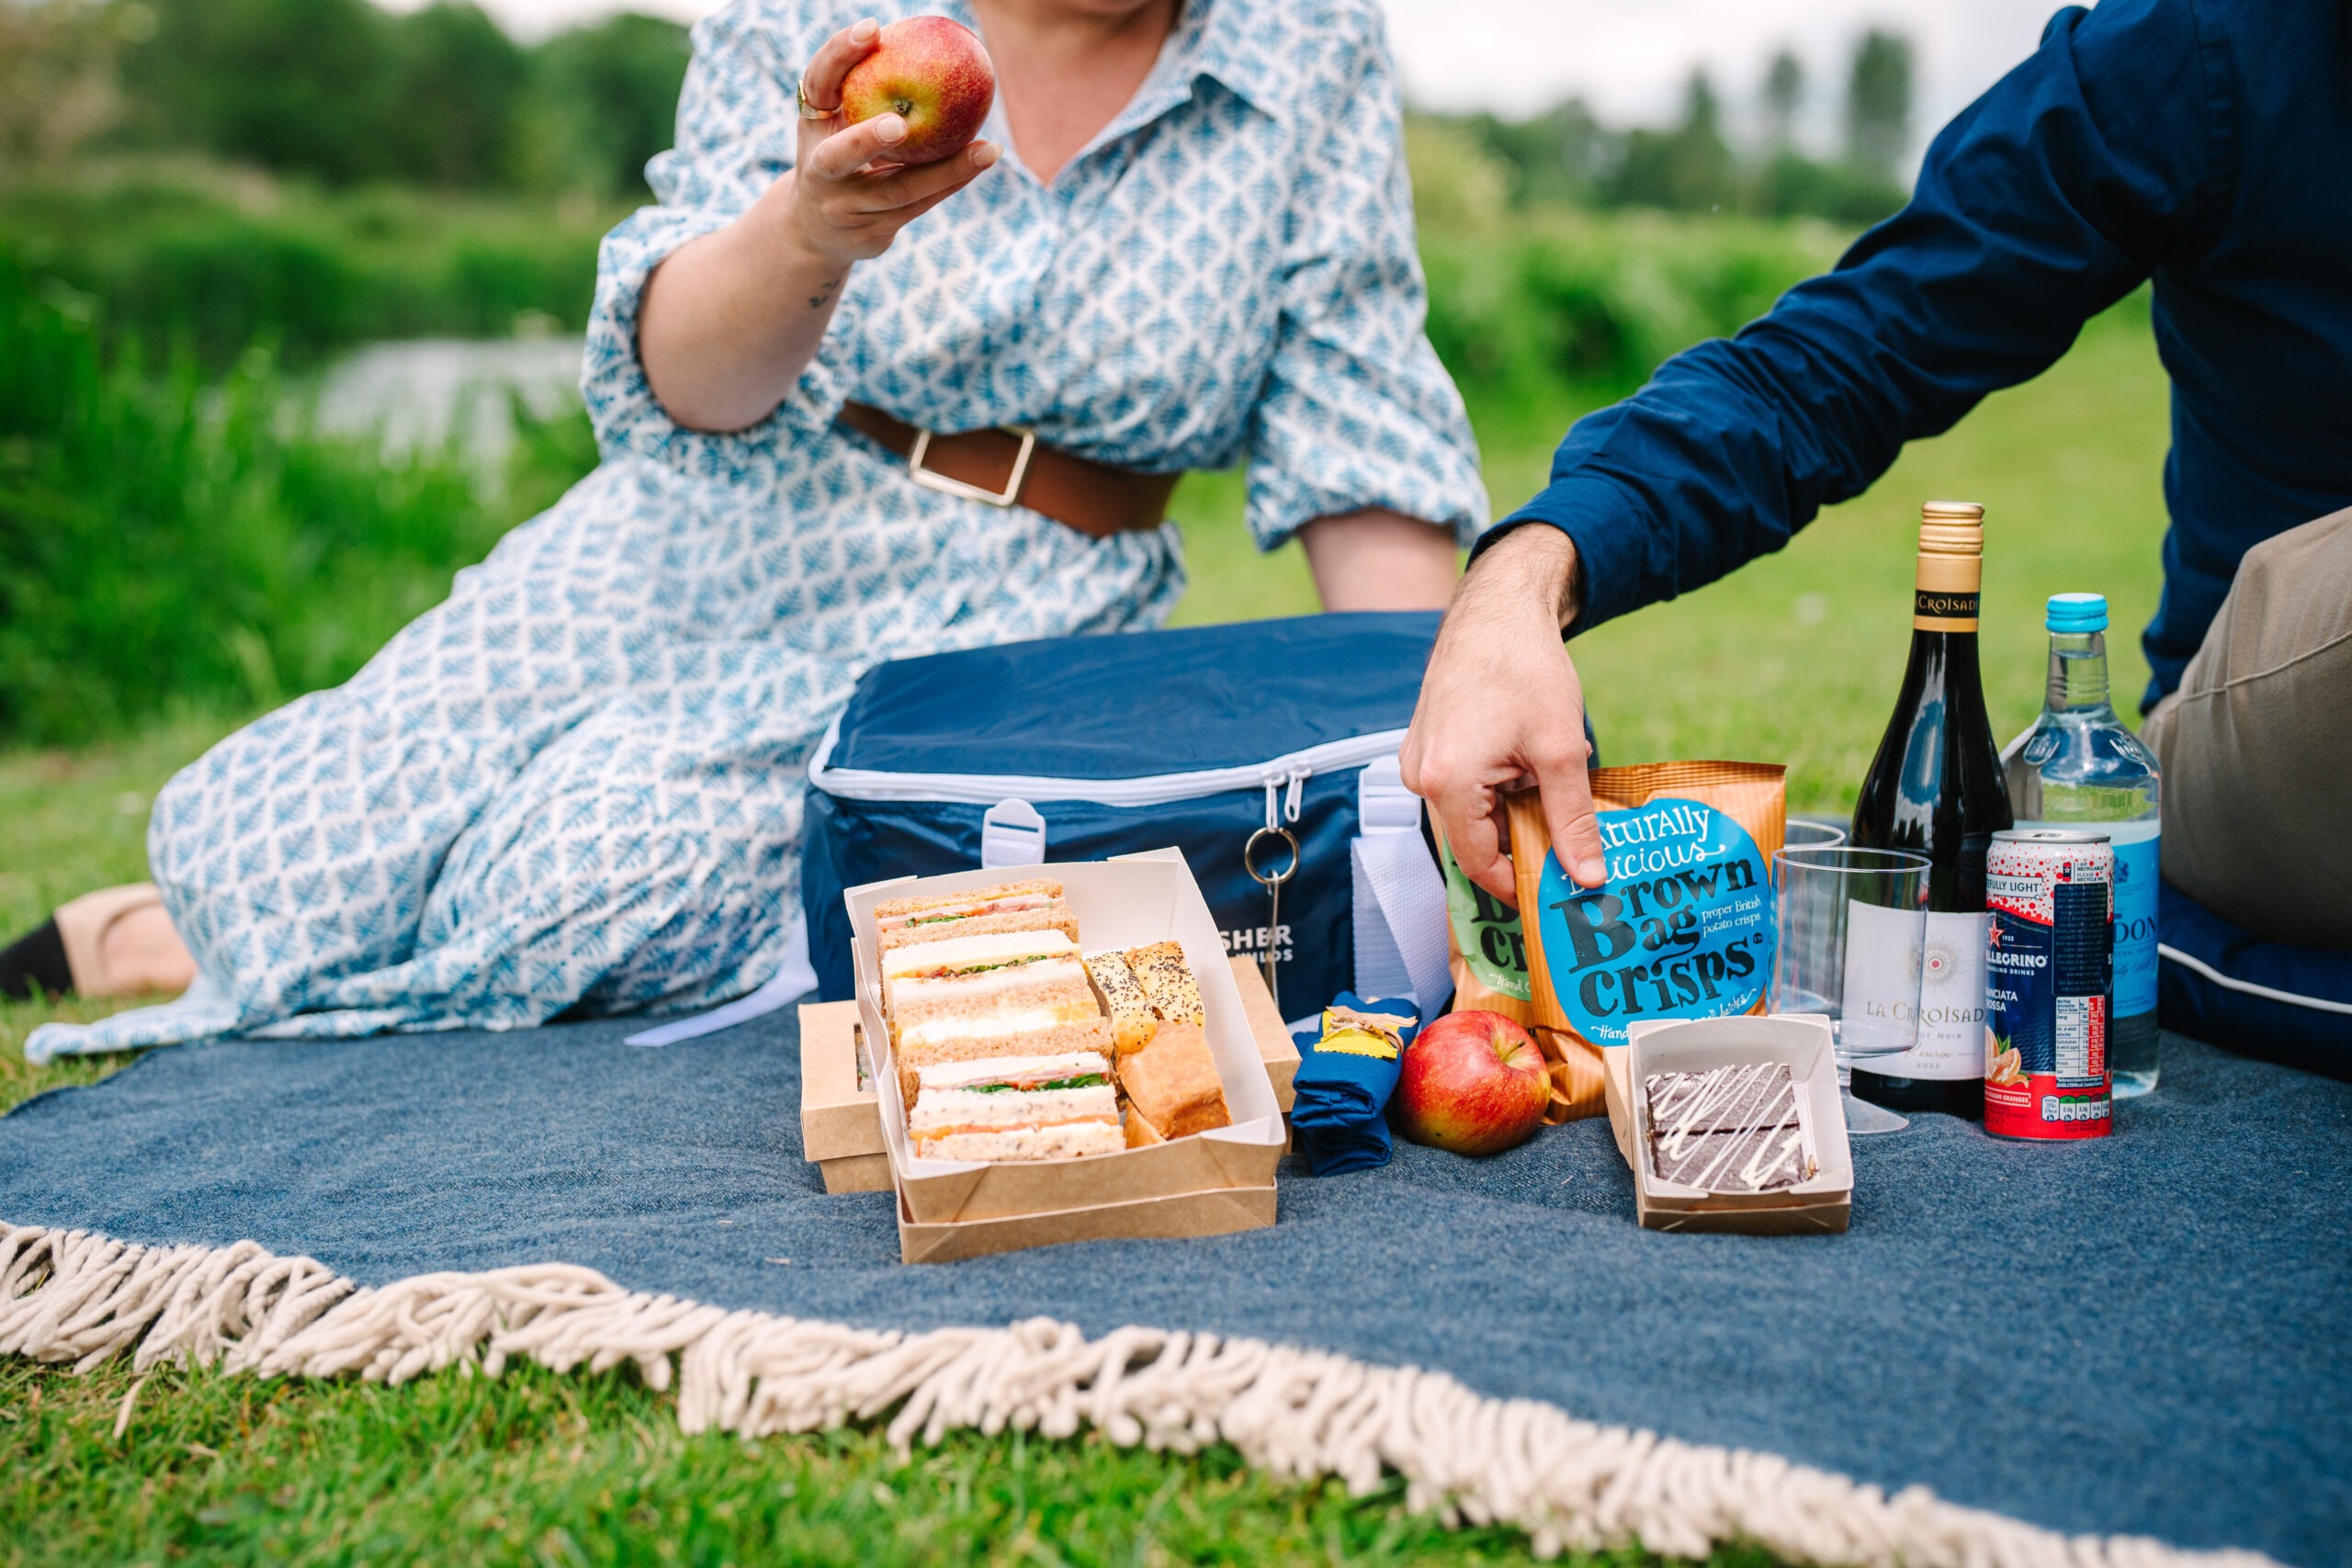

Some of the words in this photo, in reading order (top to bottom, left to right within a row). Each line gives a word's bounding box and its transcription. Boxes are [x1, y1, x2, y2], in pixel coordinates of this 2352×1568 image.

[1702, 905, 1733, 923] proper
[1735, 895, 1761, 912] British
[1703, 918, 1733, 937] potato
[1735, 912, 1761, 927] crisps
[1985, 949, 2047, 968] LLEGRINO
[1580, 936, 1755, 1017] crisps
[1867, 1001, 1885, 1018] LA
[2003, 1095, 2029, 1103] ORANGES
